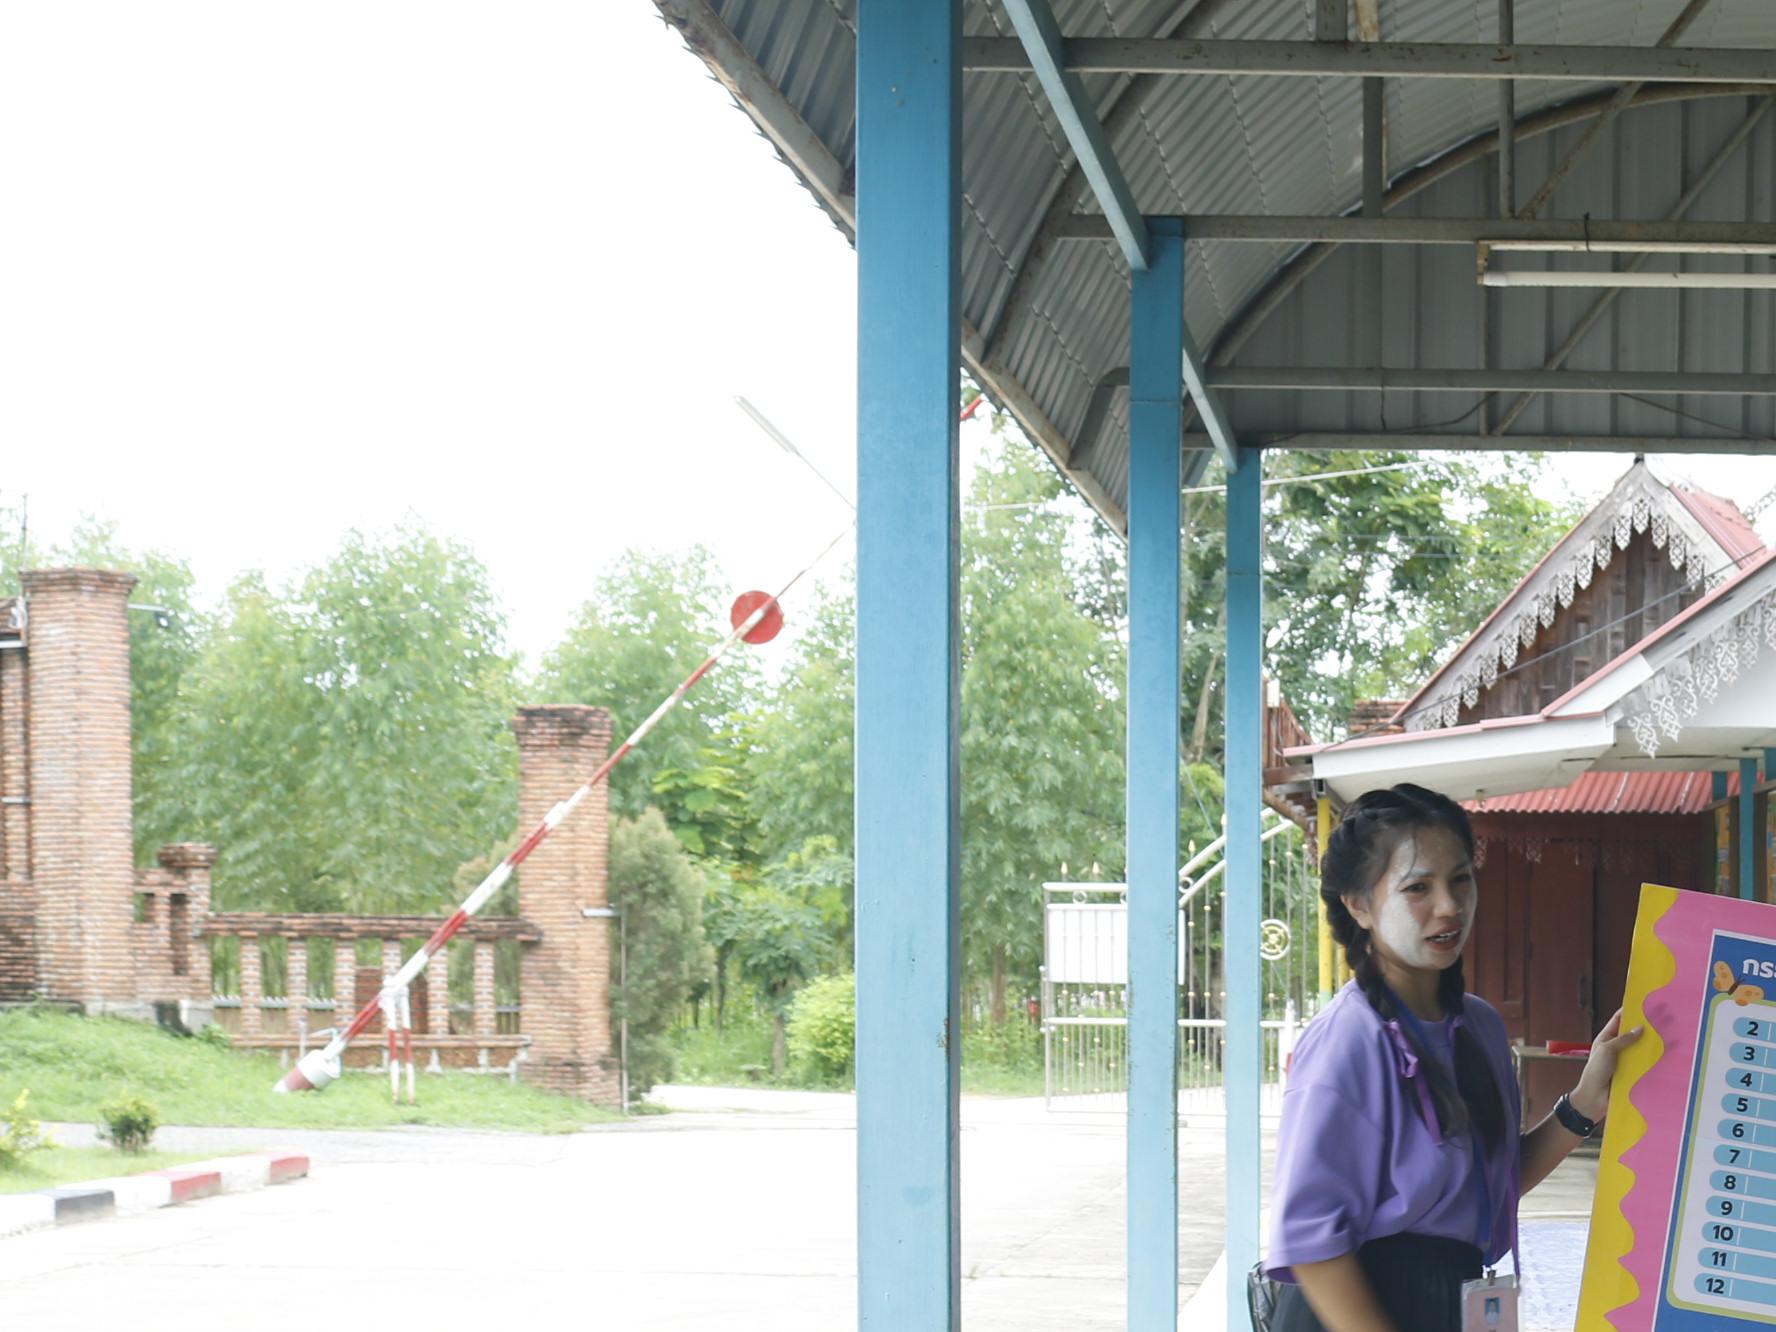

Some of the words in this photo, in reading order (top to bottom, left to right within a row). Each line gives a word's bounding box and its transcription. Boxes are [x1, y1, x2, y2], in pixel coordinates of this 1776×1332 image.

[1746, 1021, 1760, 1036] 2
[1743, 1046, 1756, 1061] 3
[1740, 1072, 1753, 1087] 4
[1736, 1097, 1748, 1112] 5
[1732, 1123, 1745, 1138] 6
[1728, 1149, 1740, 1164] 7
[1724, 1175, 1736, 1190] 8
[1720, 1200, 1733, 1216] 9
[1712, 1225, 1734, 1241] 10
[1711, 1251, 1727, 1267] 11
[1705, 1278, 1725, 1294] 12
